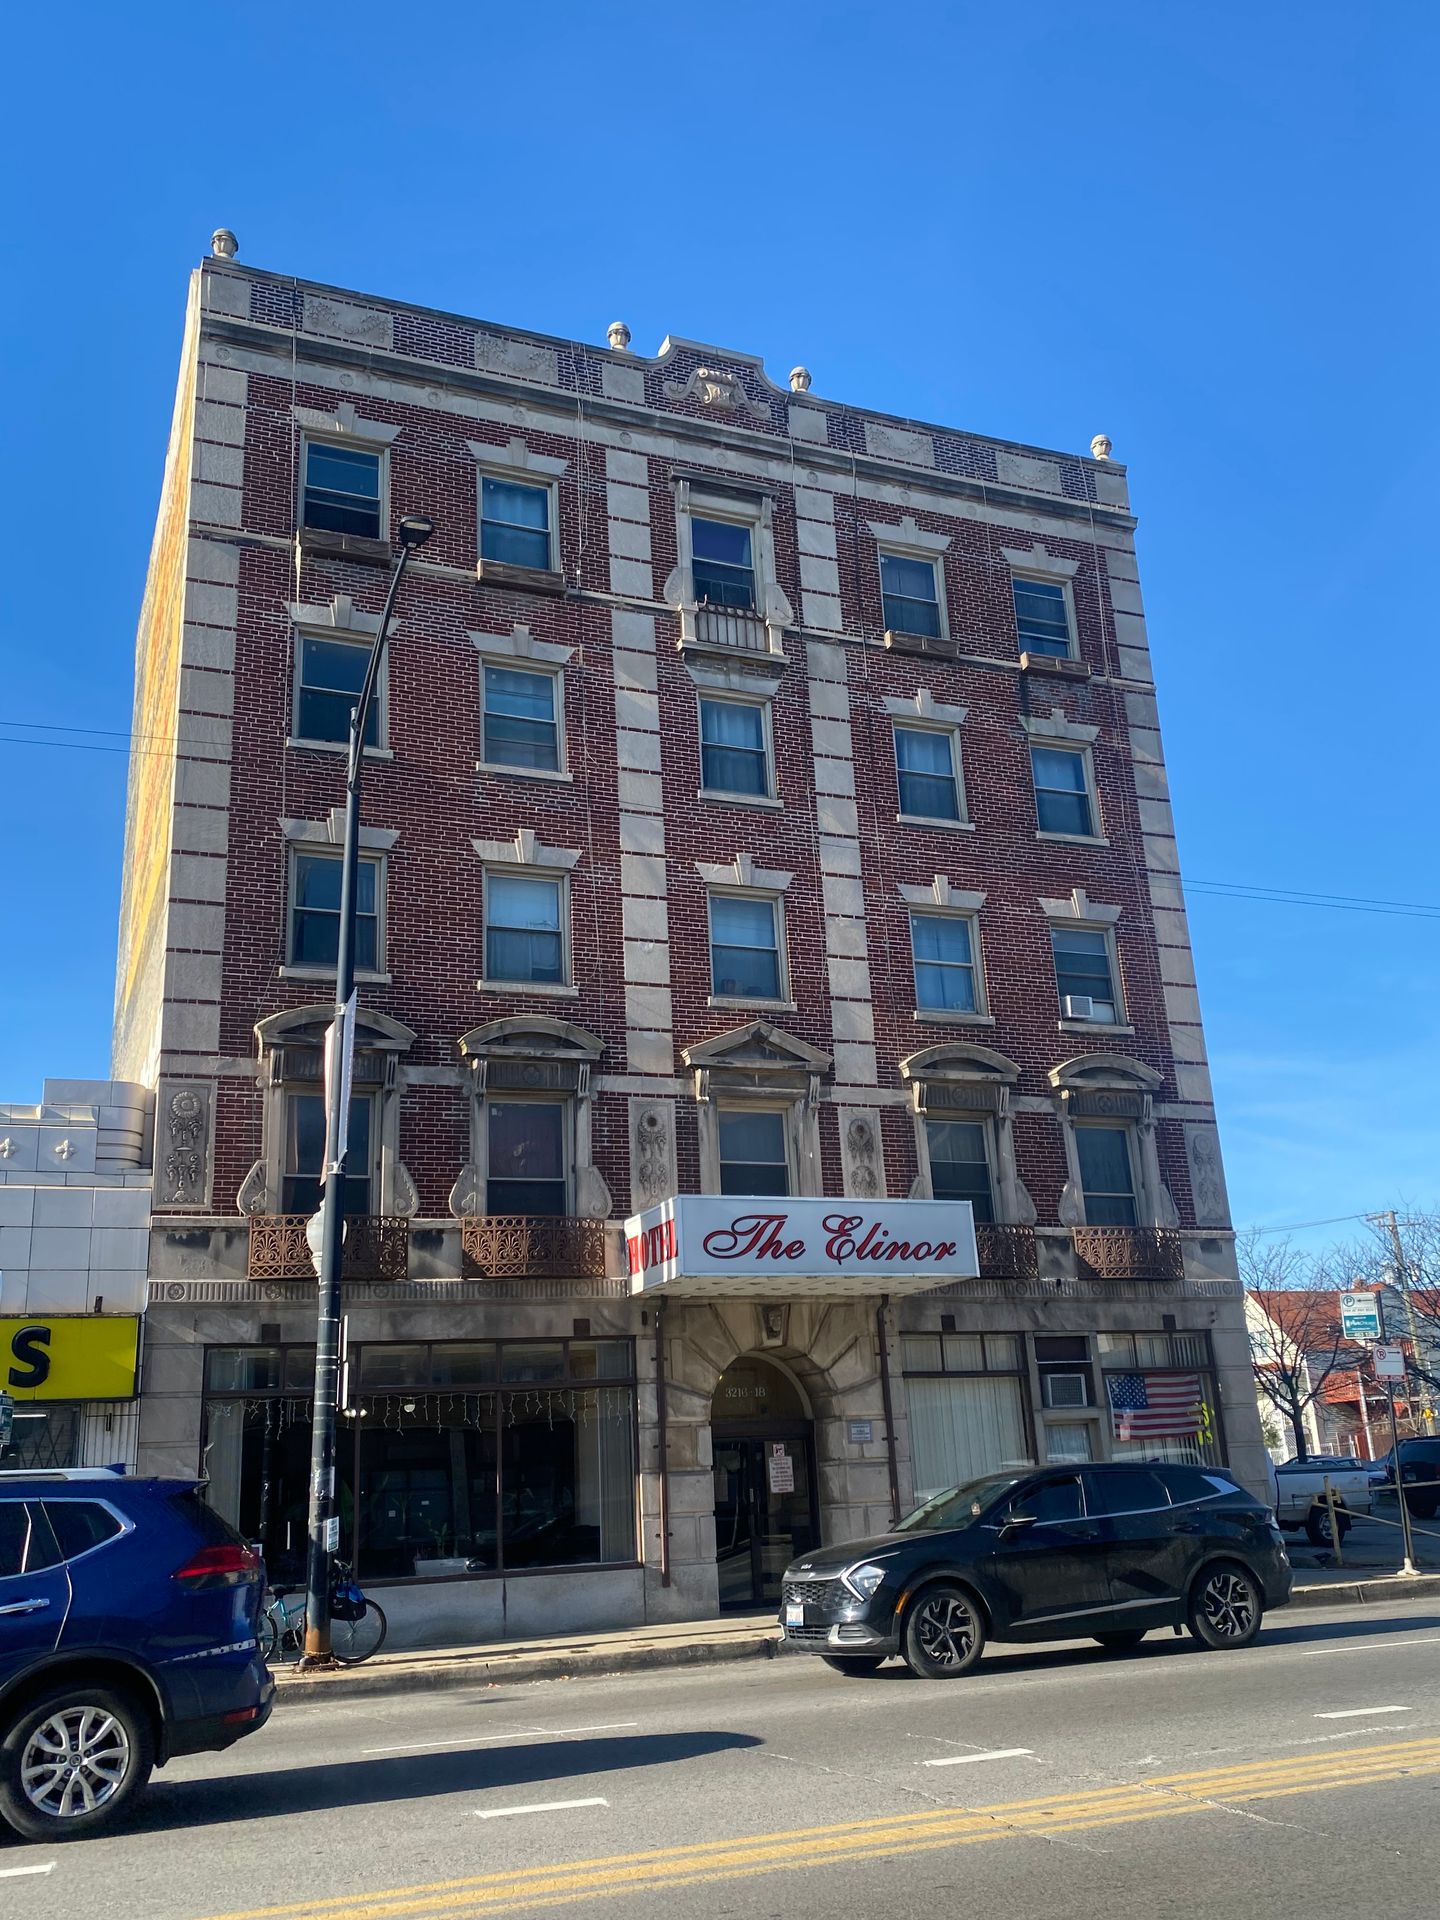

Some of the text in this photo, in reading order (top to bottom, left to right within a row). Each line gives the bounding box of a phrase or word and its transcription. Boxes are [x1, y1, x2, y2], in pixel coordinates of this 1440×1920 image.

[627, 1218, 679, 1276] HOTEL
[703, 1214, 957, 1265] The Elinor
[8, 1325, 51, 1388] S
